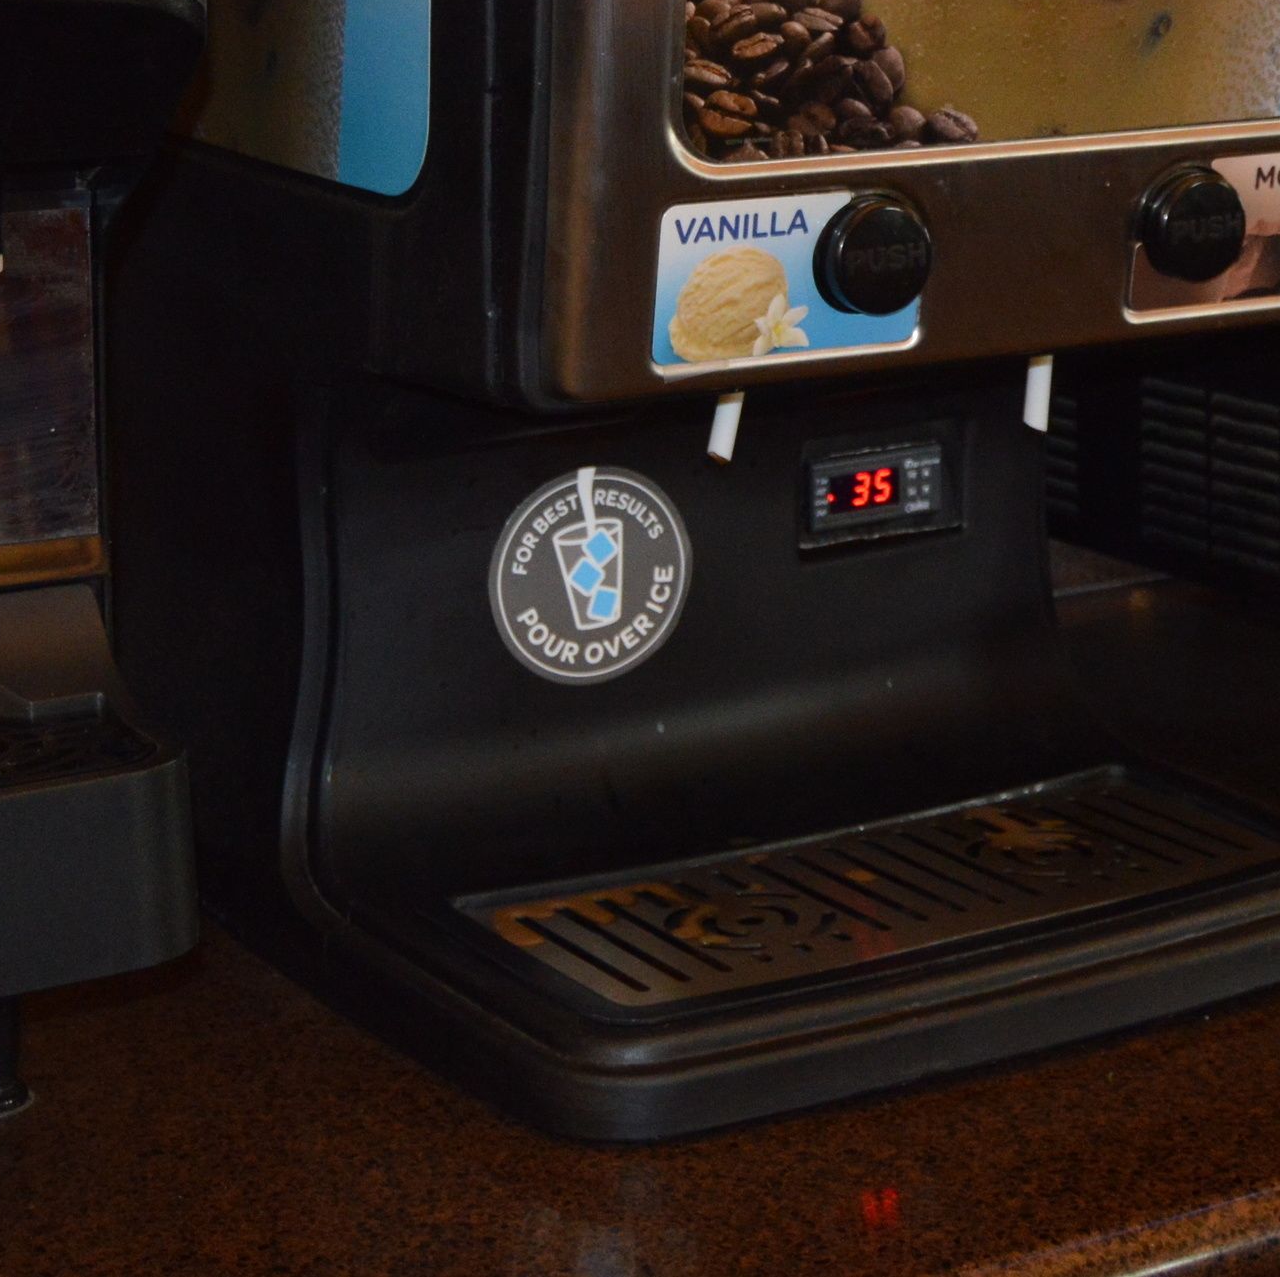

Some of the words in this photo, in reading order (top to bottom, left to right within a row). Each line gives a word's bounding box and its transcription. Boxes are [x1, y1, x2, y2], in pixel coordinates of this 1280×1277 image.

[674, 209, 810, 245] VANILLA
[850, 467, 893, 507] 35
[512, 531, 540, 576] FOR
[532, 494, 578, 535] BEST
[594, 488, 665, 540] RESULTS
[517, 607, 580, 665] POUR
[584, 613, 655, 665] OVER
[645, 564, 674, 615] ICE
